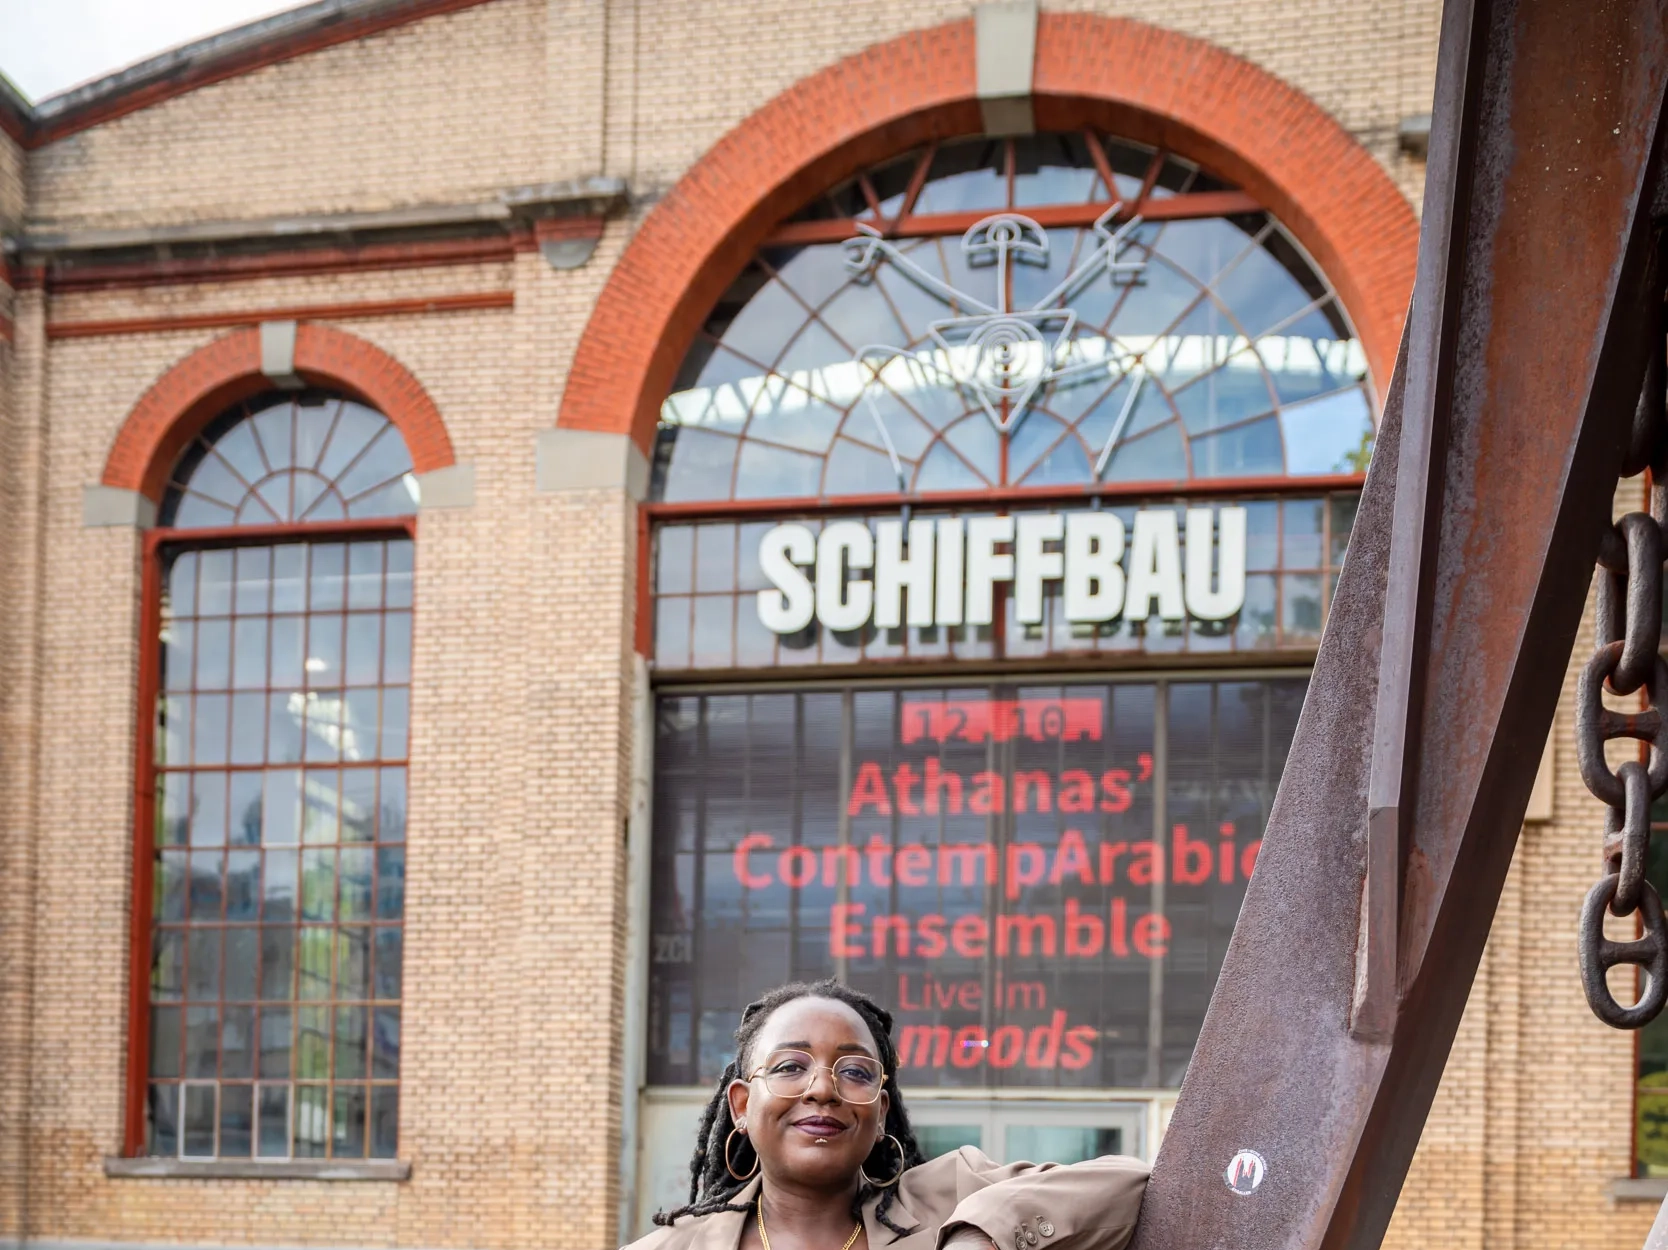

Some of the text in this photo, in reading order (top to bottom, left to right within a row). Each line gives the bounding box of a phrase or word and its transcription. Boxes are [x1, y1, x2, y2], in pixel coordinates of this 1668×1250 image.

[757, 506, 1247, 634] SCHIFFBAU
[829, 897, 1172, 959] Ensemble
[899, 970, 1047, 1012] Live im
[898, 1008, 1098, 1070] moods
